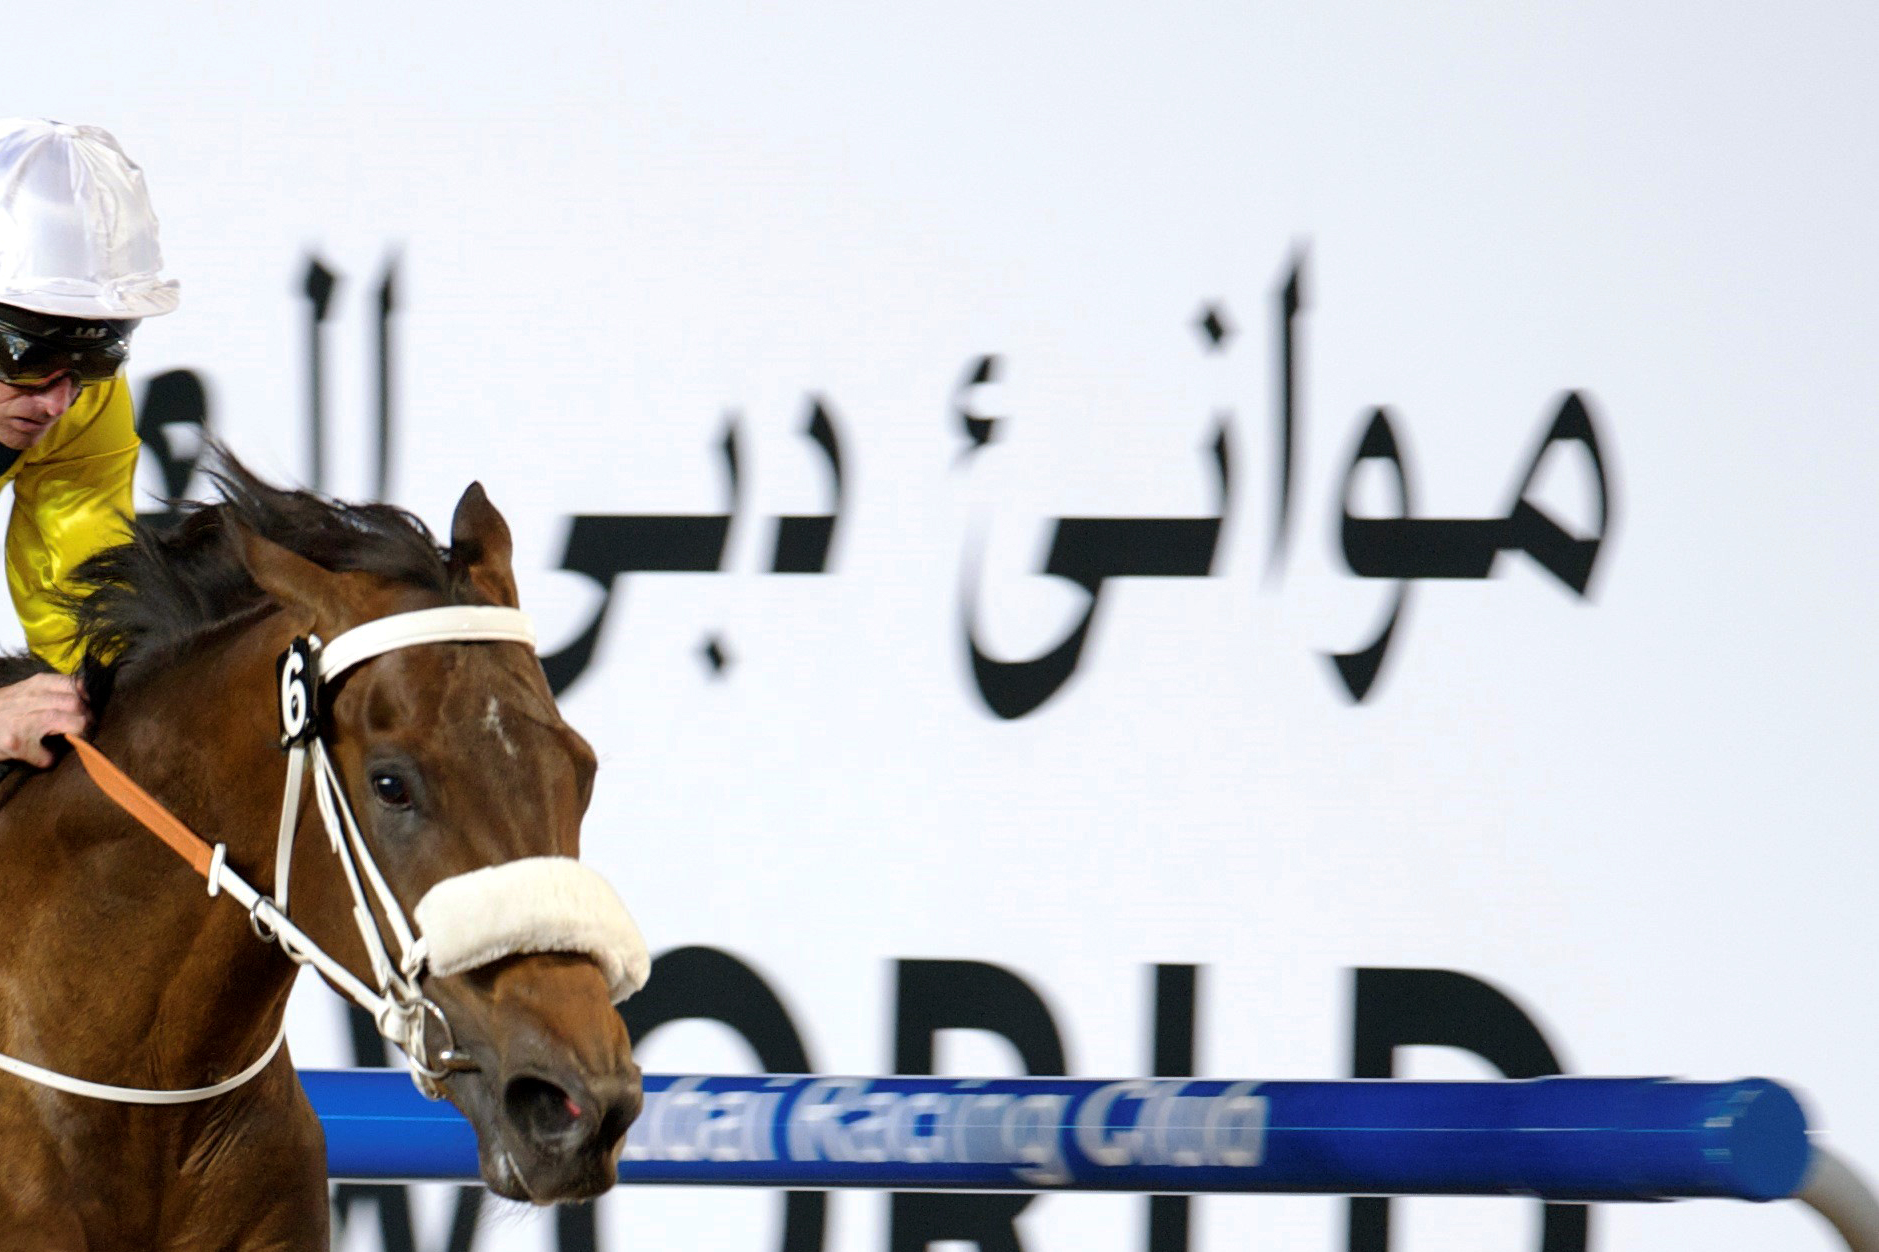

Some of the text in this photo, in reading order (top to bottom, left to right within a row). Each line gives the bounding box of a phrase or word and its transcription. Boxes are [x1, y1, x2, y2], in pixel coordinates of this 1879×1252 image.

[281, 652, 307, 738] 6
[788, 1077, 1074, 1186] Racing
[1075, 1078, 1271, 1168] Club
